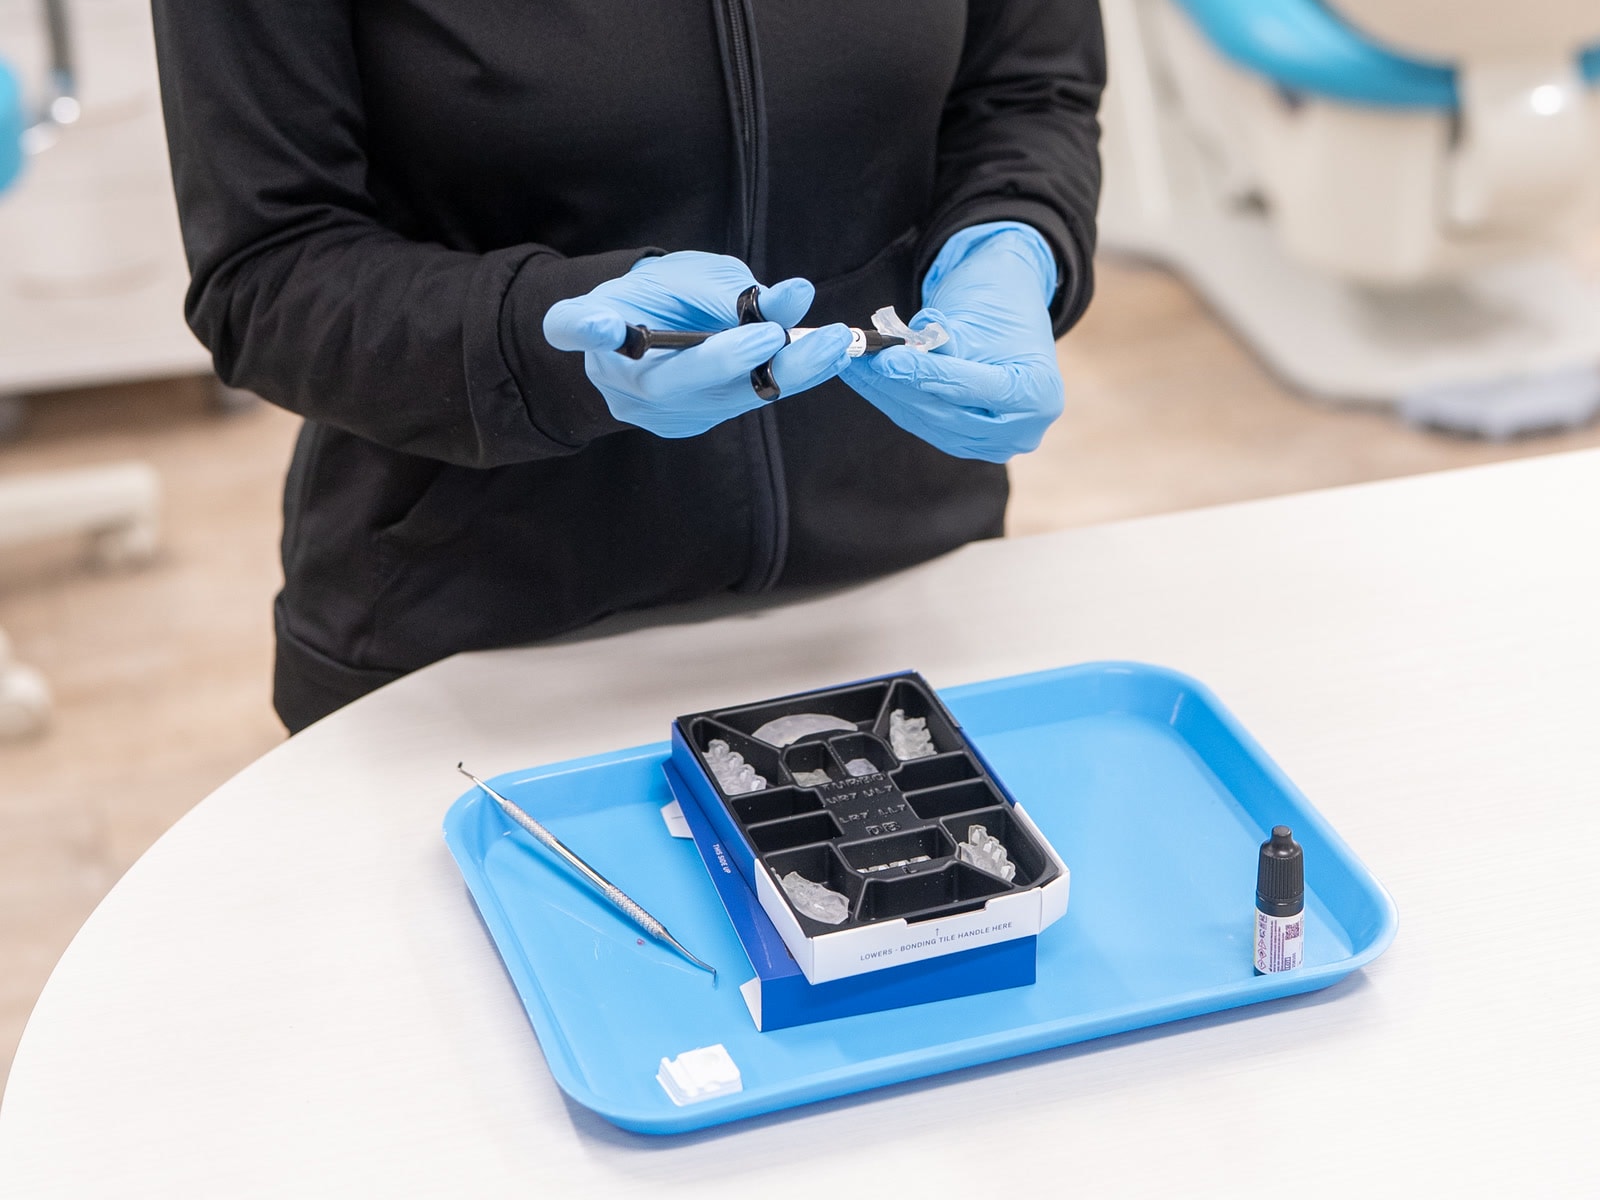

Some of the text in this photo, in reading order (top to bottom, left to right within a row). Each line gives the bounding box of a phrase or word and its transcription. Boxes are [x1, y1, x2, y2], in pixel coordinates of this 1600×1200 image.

[712, 843, 723, 856] THIS
[717, 855, 728, 867] SIDE
[860, 948, 893, 961] LOWERS
[900, 938, 937, 952] BONDING
[939, 934, 956, 944] TILE
[957, 927, 990, 939] HANDLE
[992, 921, 1013, 932] HERE
